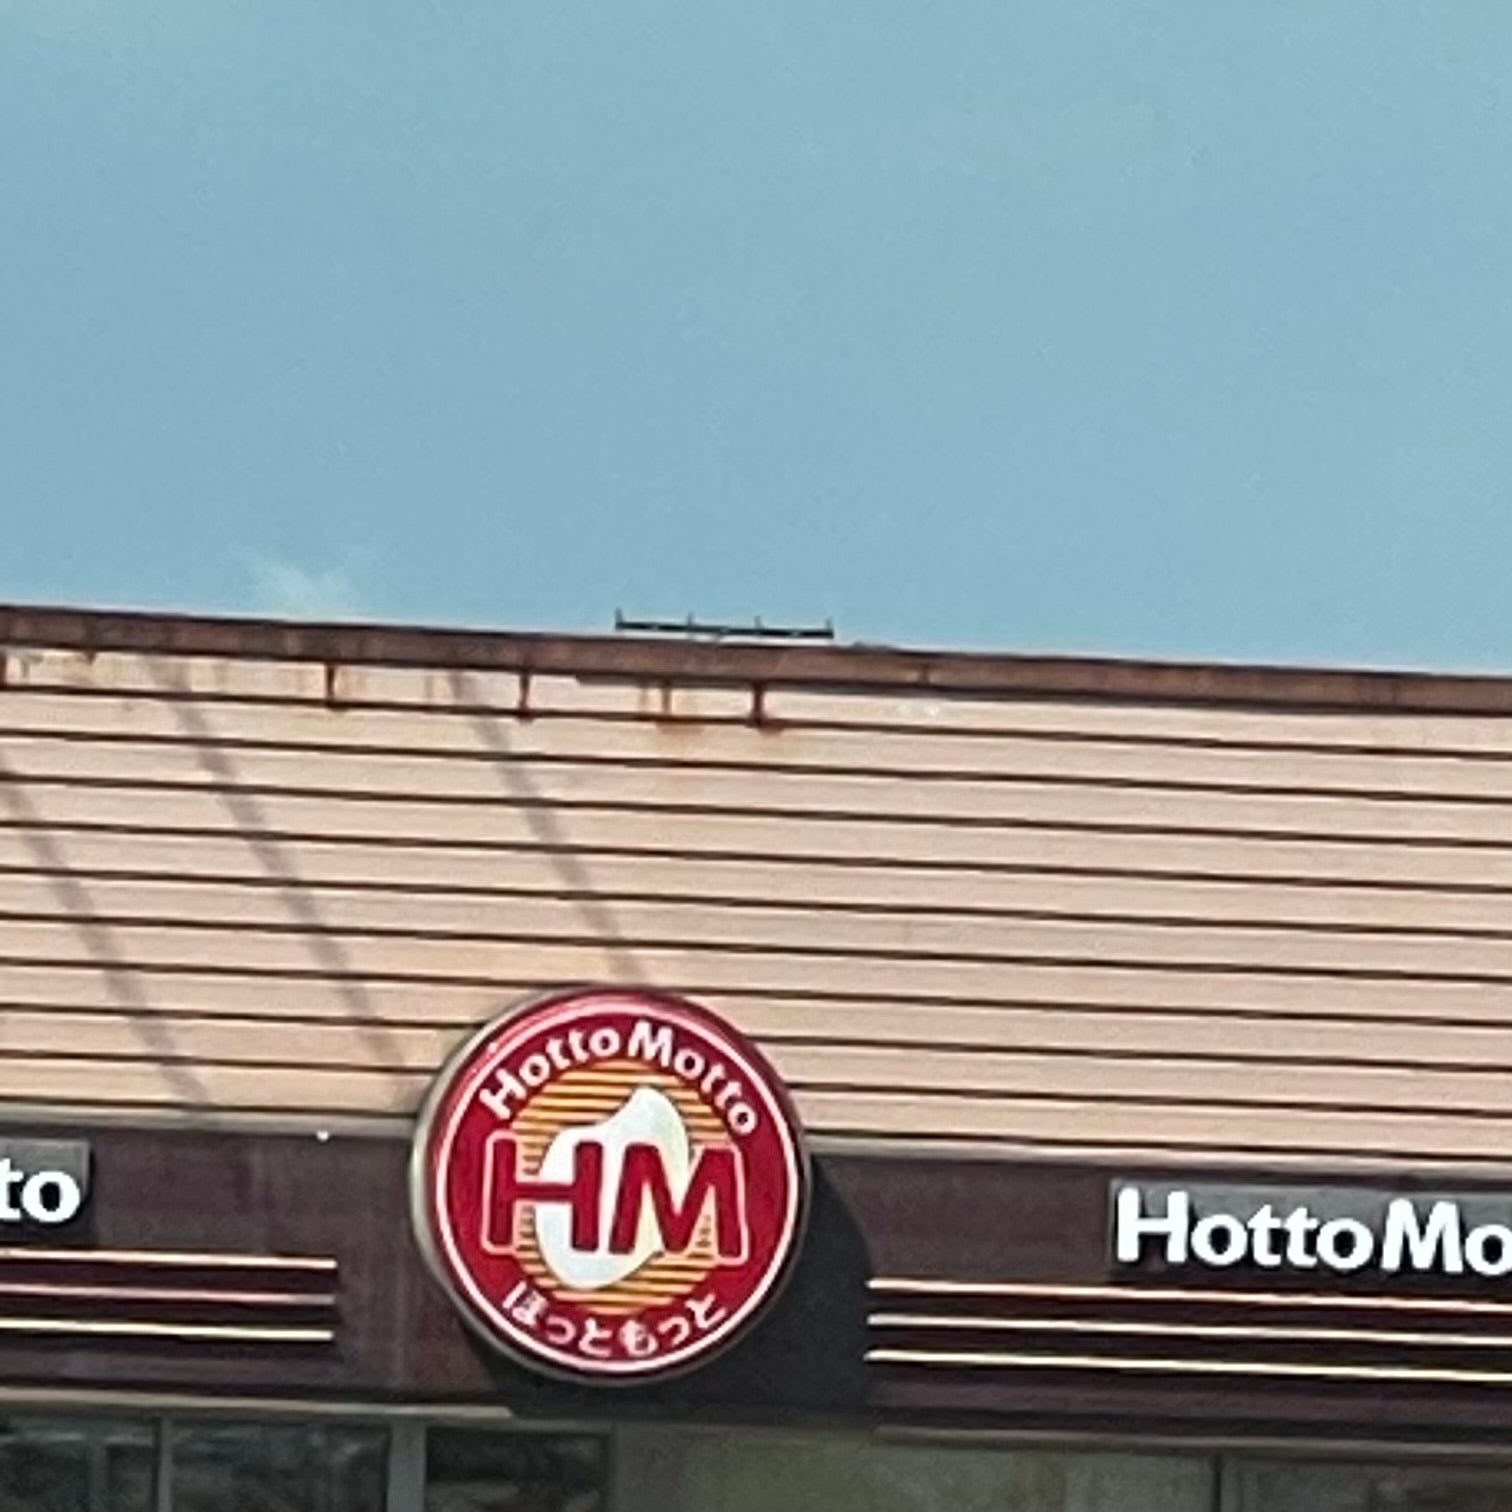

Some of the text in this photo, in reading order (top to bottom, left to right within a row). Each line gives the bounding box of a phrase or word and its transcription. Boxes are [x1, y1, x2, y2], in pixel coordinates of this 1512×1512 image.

[480, 1130, 749, 1267] HM
[502, 1281, 727, 1357] ほっともっと
